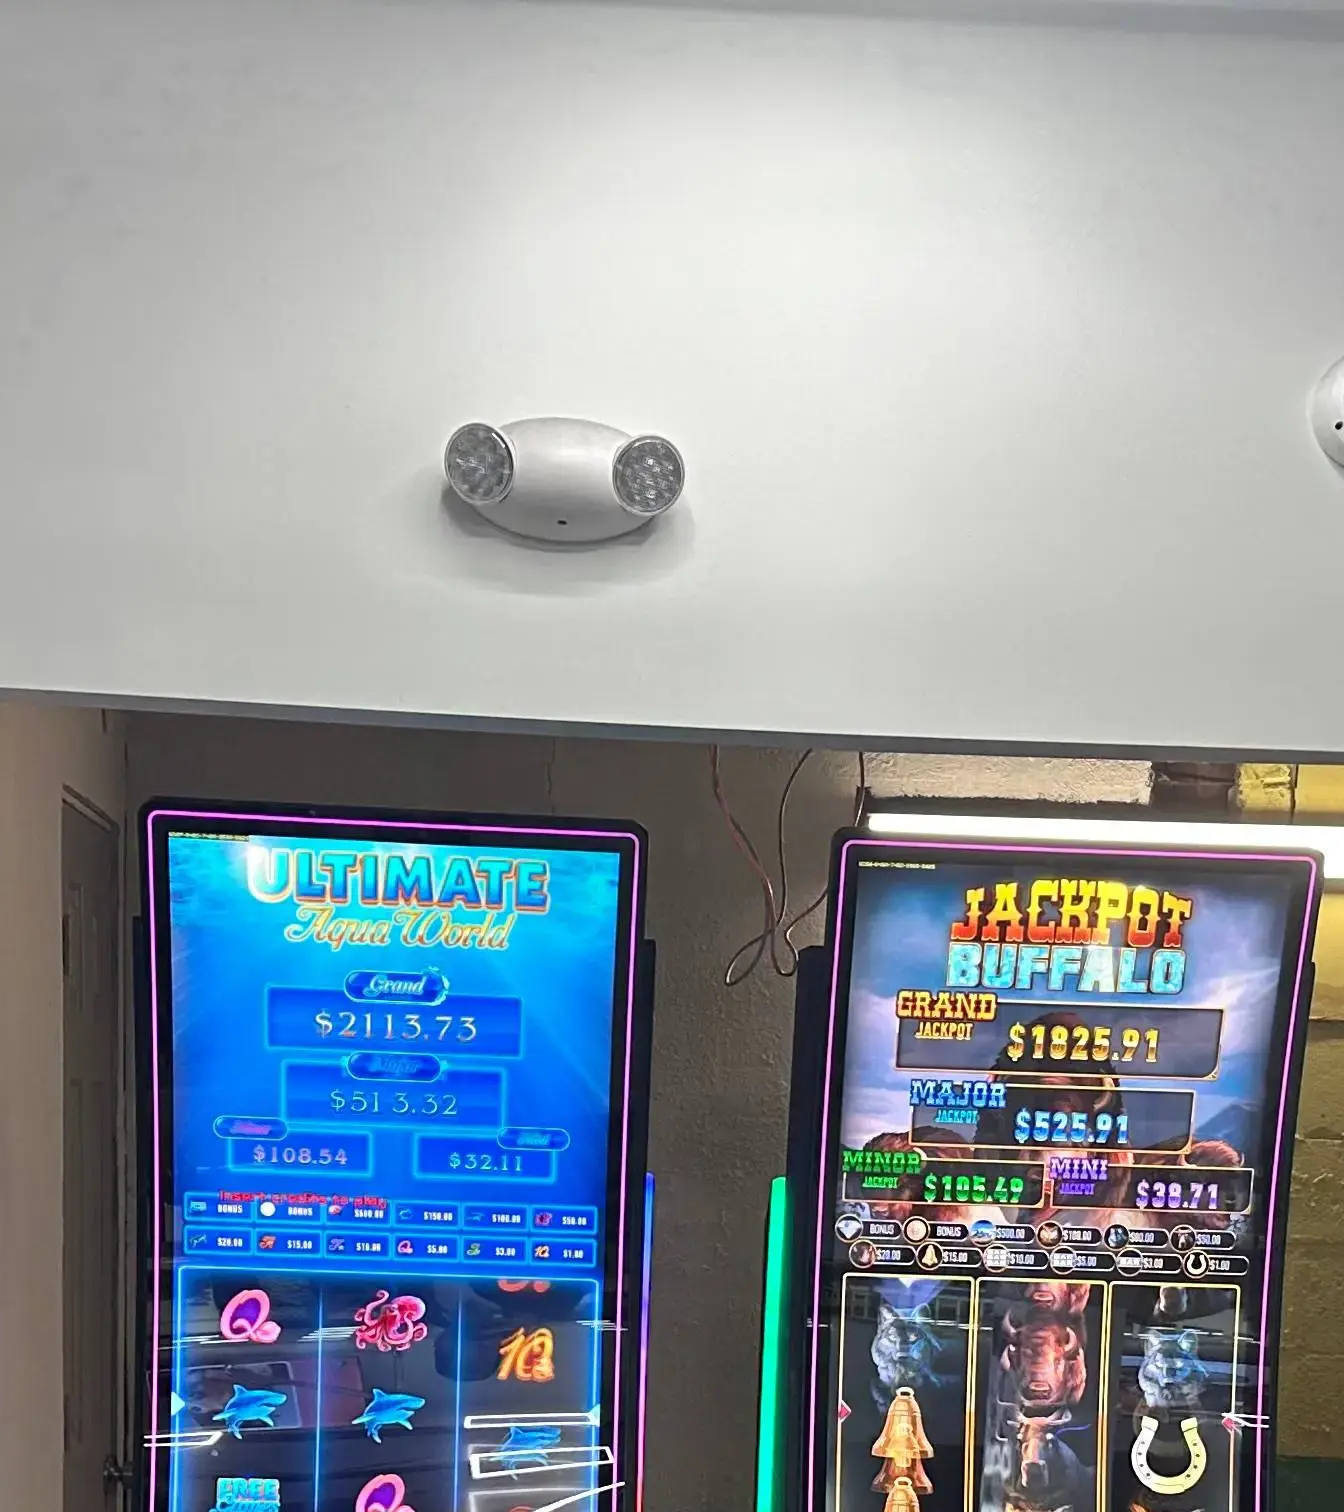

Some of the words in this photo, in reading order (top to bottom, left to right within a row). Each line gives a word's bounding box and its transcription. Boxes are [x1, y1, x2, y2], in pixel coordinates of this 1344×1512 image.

[246, 845, 550, 914] ULTIMATE
[949, 878, 1193, 949] JACKPOT
[285, 905, 391, 951] Aqua
[394, 909, 517, 950] World
[946, 942, 1187, 995] BUFFALO
[363, 975, 426, 997] Grand
[896, 989, 998, 1022] GRAND
[314, 1007, 478, 1043] $2113.73
[915, 1022, 974, 1041] JACKPOT
[1007, 1022, 1160, 1063] $1825.91
[909, 1080, 1007, 1108] MAJOR
[935, 1109, 979, 1124] JACKPOT
[1014, 1107, 1129, 1144] $525.91
[253, 1143, 349, 1167] $108.54
[449, 1152, 524, 1172] $32.11
[842, 1151, 921, 1174] MINOR
[1050, 1158, 1108, 1180] MINI
[862, 1176, 899, 1189] JACKPOT
[923, 1172, 1024, 1204] $105.49
[1059, 1182, 1096, 1195] JACKPOT
[1136, 1179, 1218, 1210] $38.71
[870, 1224, 895, 1234] BONUS
[936, 1226, 962, 1237] BONUS
[943, 1252, 968, 1263] $15.00
[1209, 1260, 1230, 1271] $1.00
[217, 1477, 280, 1502] FREE
